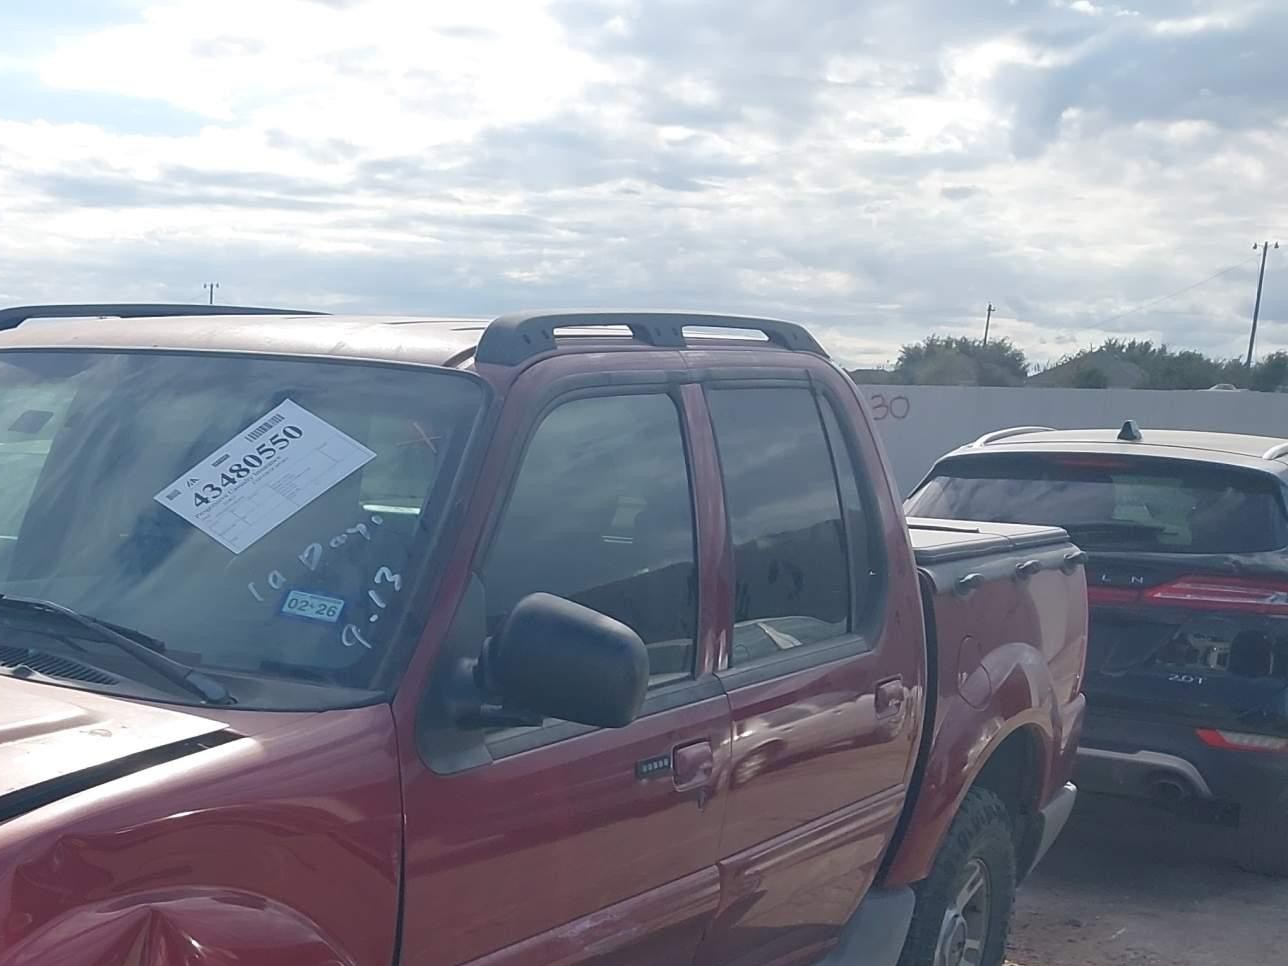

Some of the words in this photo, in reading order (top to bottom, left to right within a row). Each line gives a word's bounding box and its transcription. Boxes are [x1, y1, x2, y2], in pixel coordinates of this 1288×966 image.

[871, 394, 910, 421] 30
[194, 425, 303, 507] 43480550
[287, 598, 338, 617] 02-26
